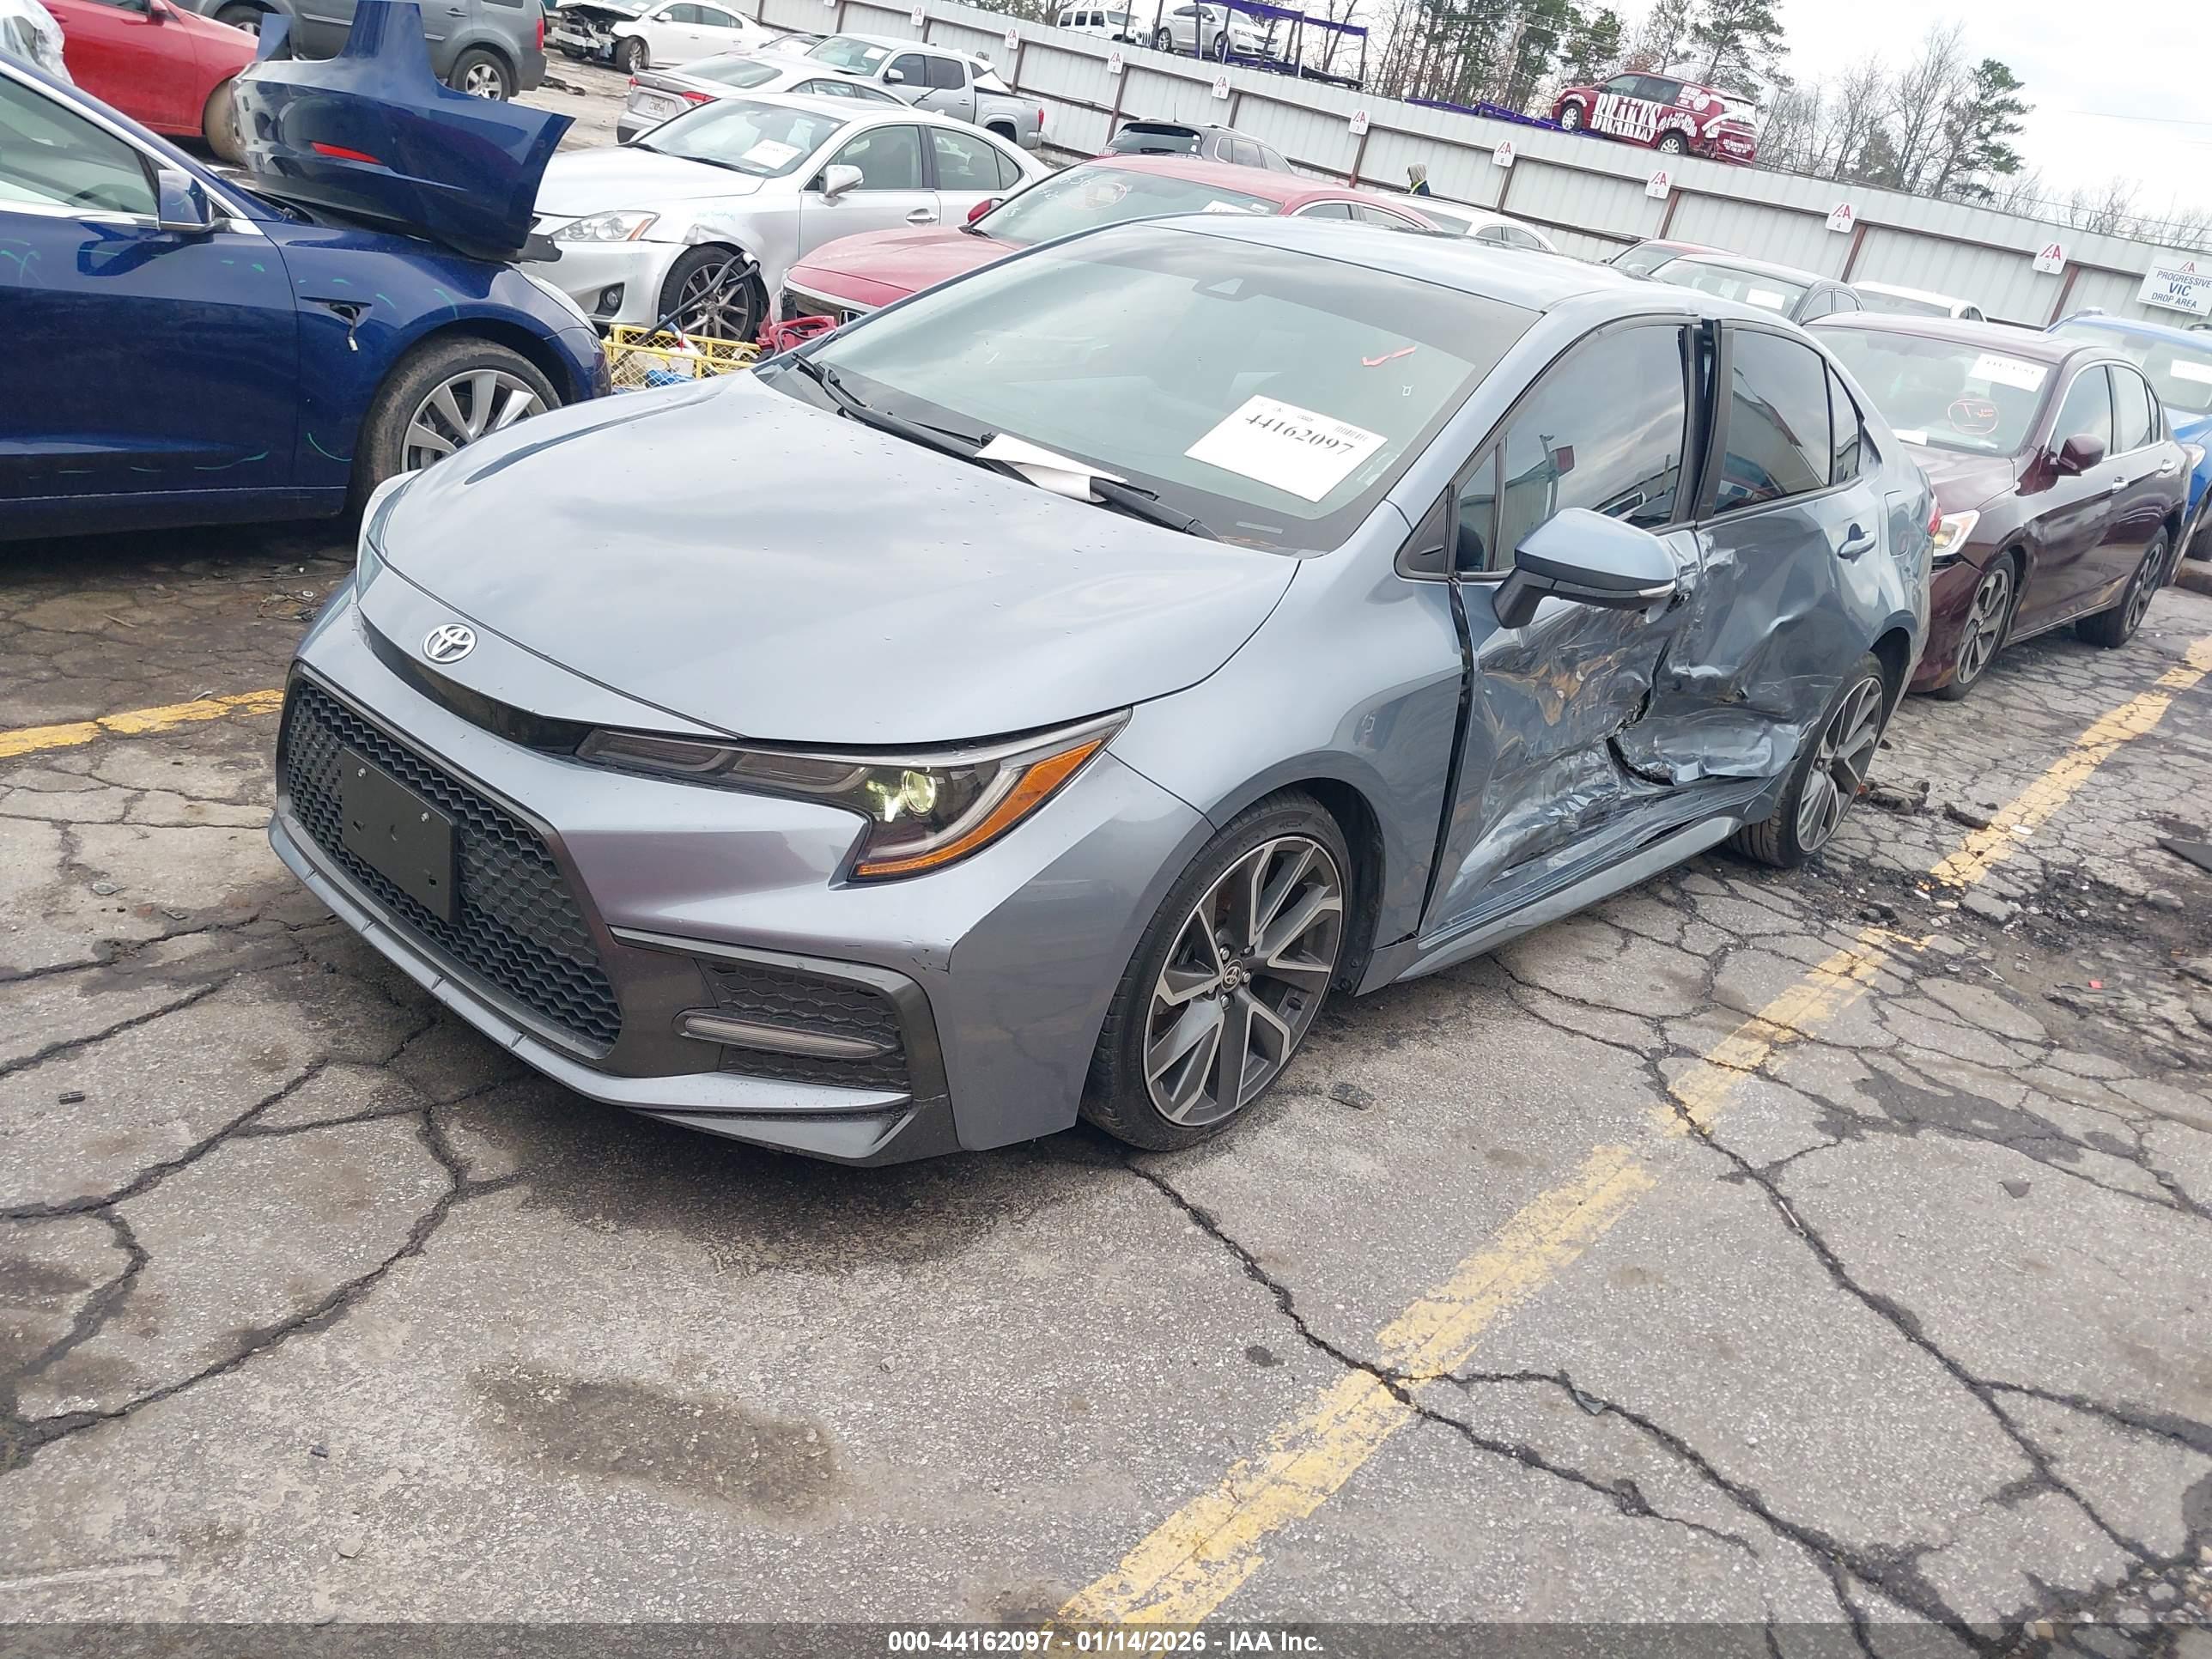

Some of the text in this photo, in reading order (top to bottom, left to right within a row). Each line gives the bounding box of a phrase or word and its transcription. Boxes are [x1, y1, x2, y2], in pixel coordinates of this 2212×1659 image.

[1590, 94, 1662, 143] BRAKES
[2044, 263, 2051, 271] 3
[2156, 270, 2212, 289] PROGRESSIVE
[2169, 282, 2192, 297] VIC
[2151, 292, 2197, 309] DROP AREA
[1245, 414, 1355, 455] 44162097
